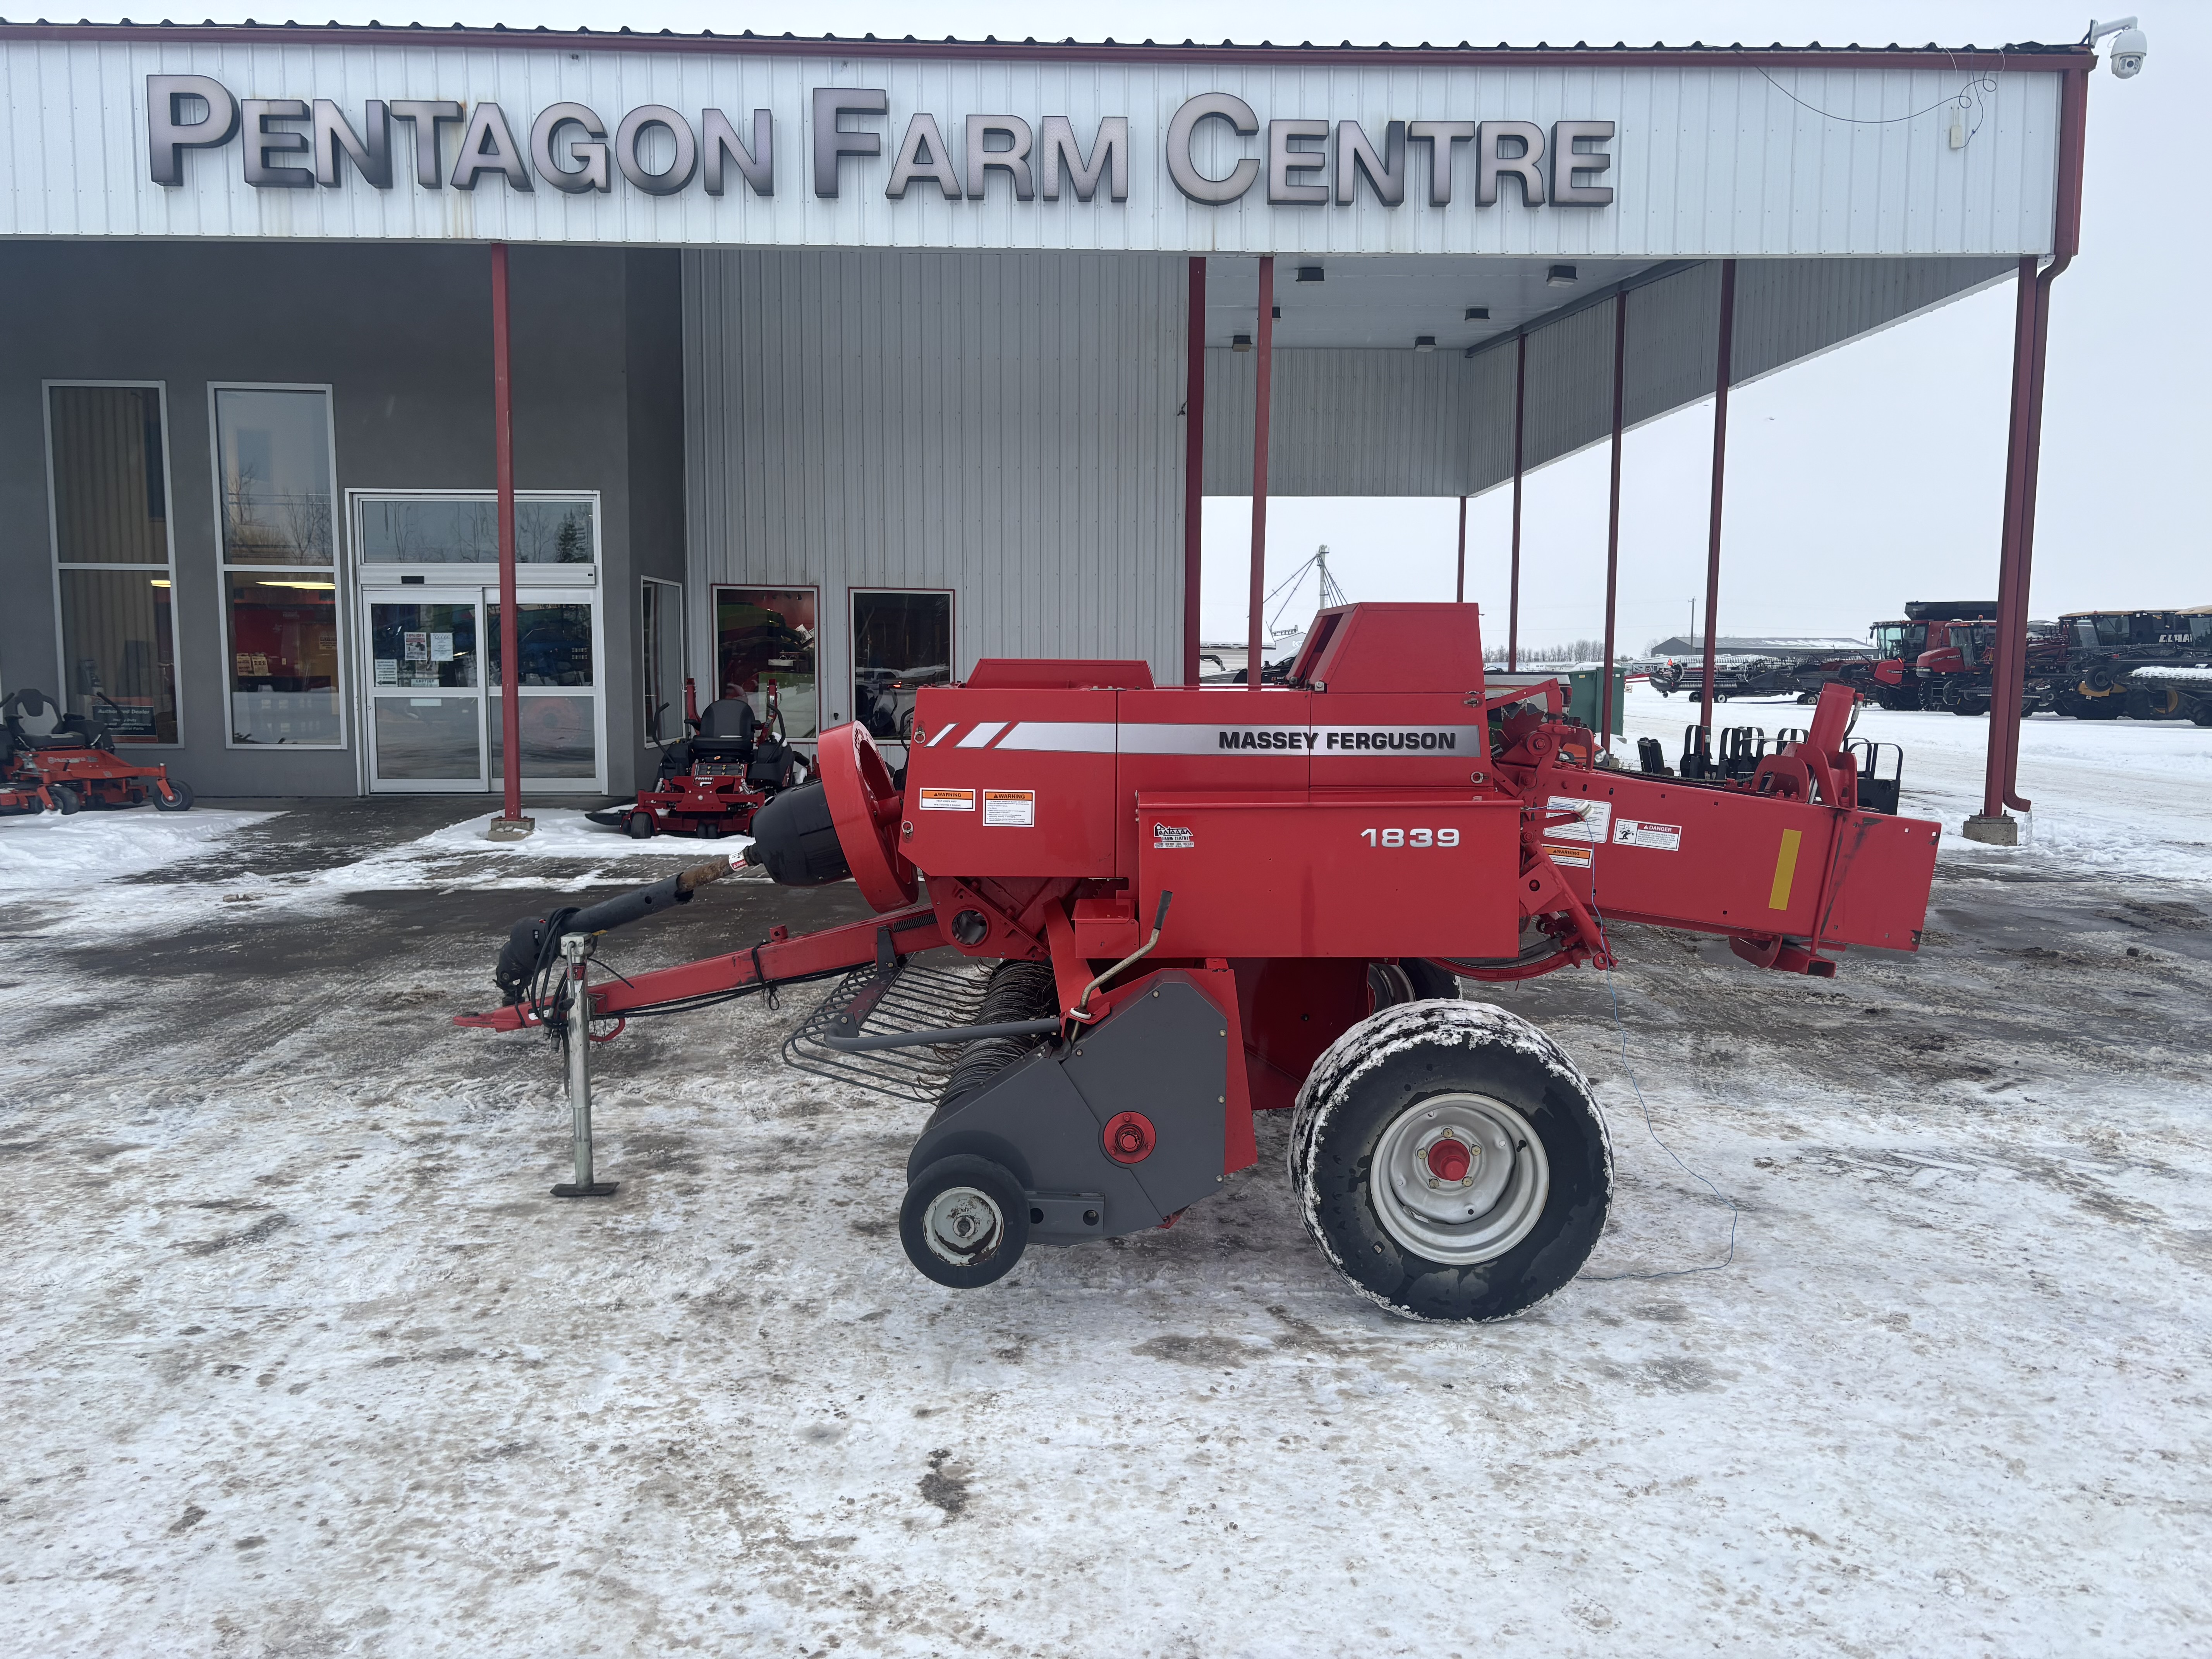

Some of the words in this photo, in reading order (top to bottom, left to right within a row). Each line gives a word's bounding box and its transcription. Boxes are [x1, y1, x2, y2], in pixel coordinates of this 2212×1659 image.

[146, 74, 775, 196] PENTAGON
[812, 88, 1128, 202] FARM
[1166, 92, 1615, 207] CENTRE
[1219, 732, 1319, 749] MASSEY
[1327, 732, 1456, 750] FERGUSON
[1155, 824, 1192, 836] Pentagon
[1360, 828, 1459, 847] 1839
